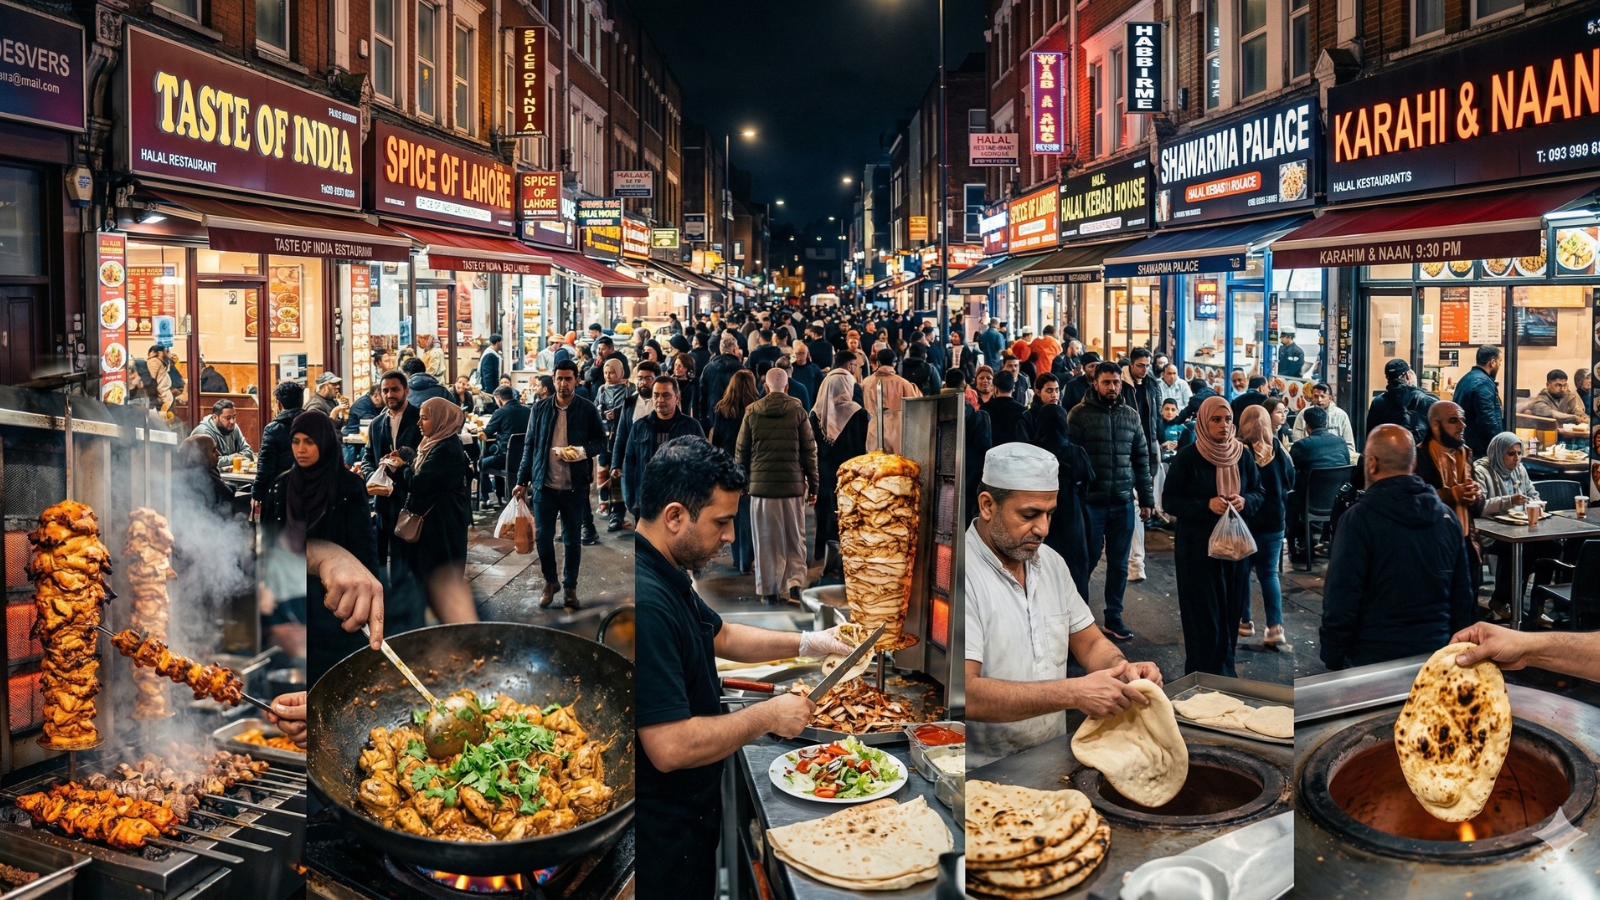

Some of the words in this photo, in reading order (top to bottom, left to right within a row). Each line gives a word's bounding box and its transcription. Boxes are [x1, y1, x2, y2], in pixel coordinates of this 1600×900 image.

[0, 38, 70, 77] ESVERS
[523, 29, 536, 70] SPICE
[1134, 25, 1155, 109] HABBIRME
[523, 89, 536, 130] INDIA
[1334, 87, 1446, 163] KARAHI
[1456, 81, 1480, 140] &
[1491, 48, 1600, 133] NAAN
[154, 71, 251, 151] TASTE
[255, 104, 290, 159] OF
[293, 114, 354, 175] INDIA
[977, 136, 1011, 144] HALAL
[1160, 127, 1239, 185] SHAWARMA
[1242, 104, 1310, 164] PALACE
[1548, 147, 1567, 161] 093
[1569, 143, 1589, 158] 999
[141, 148, 168, 164] HALAL
[169, 153, 217, 173] RESTAURANT
[385, 134, 436, 192] SPICE
[440, 152, 460, 196] OF
[462, 159, 512, 209] LAHORE
[523, 175, 557, 187] SPICE
[533, 188, 547, 197] OF
[1333, 180, 1355, 192] HALAL
[523, 198, 558, 209] LAHORE
[1061, 194, 1084, 222] HALAL
[1085, 186, 1113, 218] KEBAB
[1114, 176, 1146, 212] HOUSE
[274, 237, 300, 252] TASTE
[301, 240, 312, 254] OF
[313, 241, 334, 255] INDIA
[1368, 247, 1376, 261] &
[1378, 245, 1414, 261] NAAN,
[1416, 242, 1439, 258] 9:30
[1442, 241, 1461, 257] PM
[1172, 260, 1199, 272] PALACE
